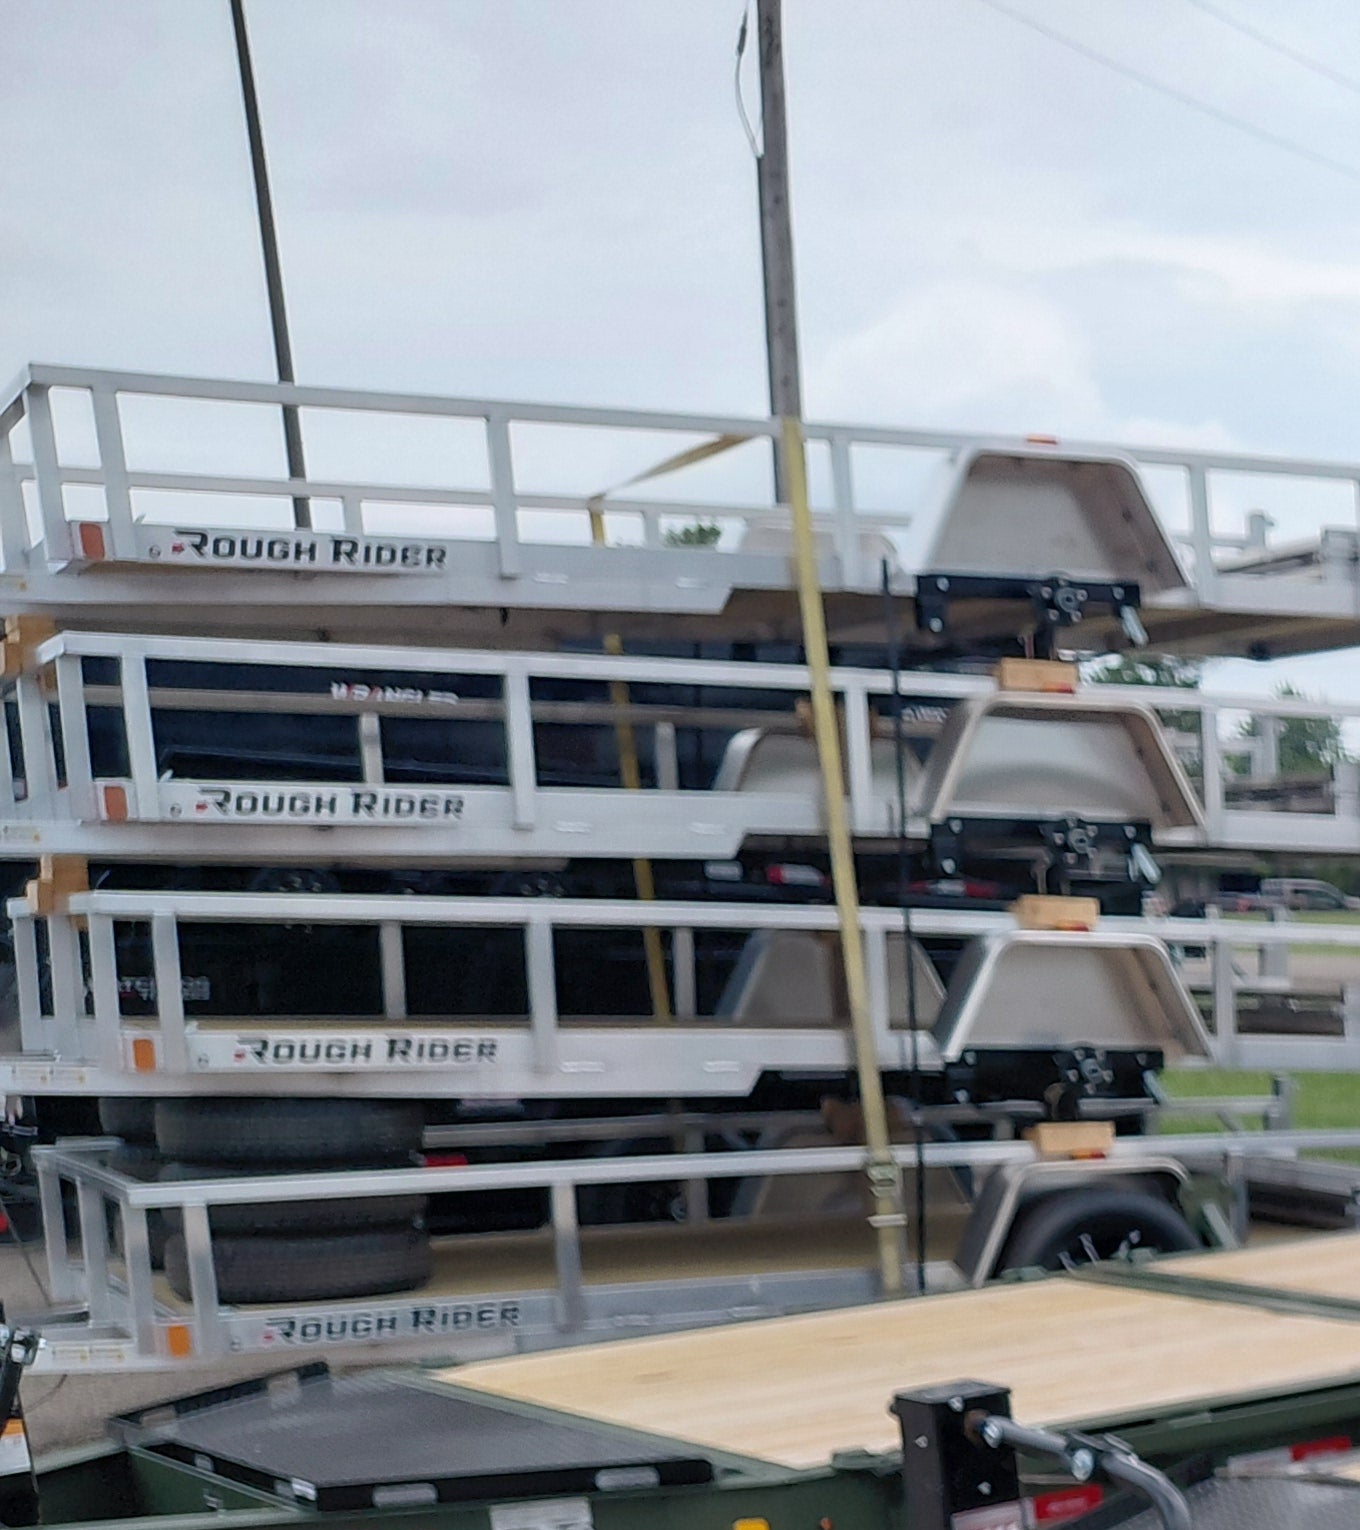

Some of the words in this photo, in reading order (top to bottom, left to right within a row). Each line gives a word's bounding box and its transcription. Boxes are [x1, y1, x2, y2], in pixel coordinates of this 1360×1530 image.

[173, 528, 317, 563] ROUGH
[330, 535, 447, 569] RIDER
[197, 786, 337, 817] ROUGH
[351, 789, 465, 819] RIDER
[236, 1033, 373, 1064] ROUGH
[385, 1032, 498, 1063] RIDER
[265, 1311, 397, 1344] ROUGH
[409, 1300, 520, 1332] RIDER
